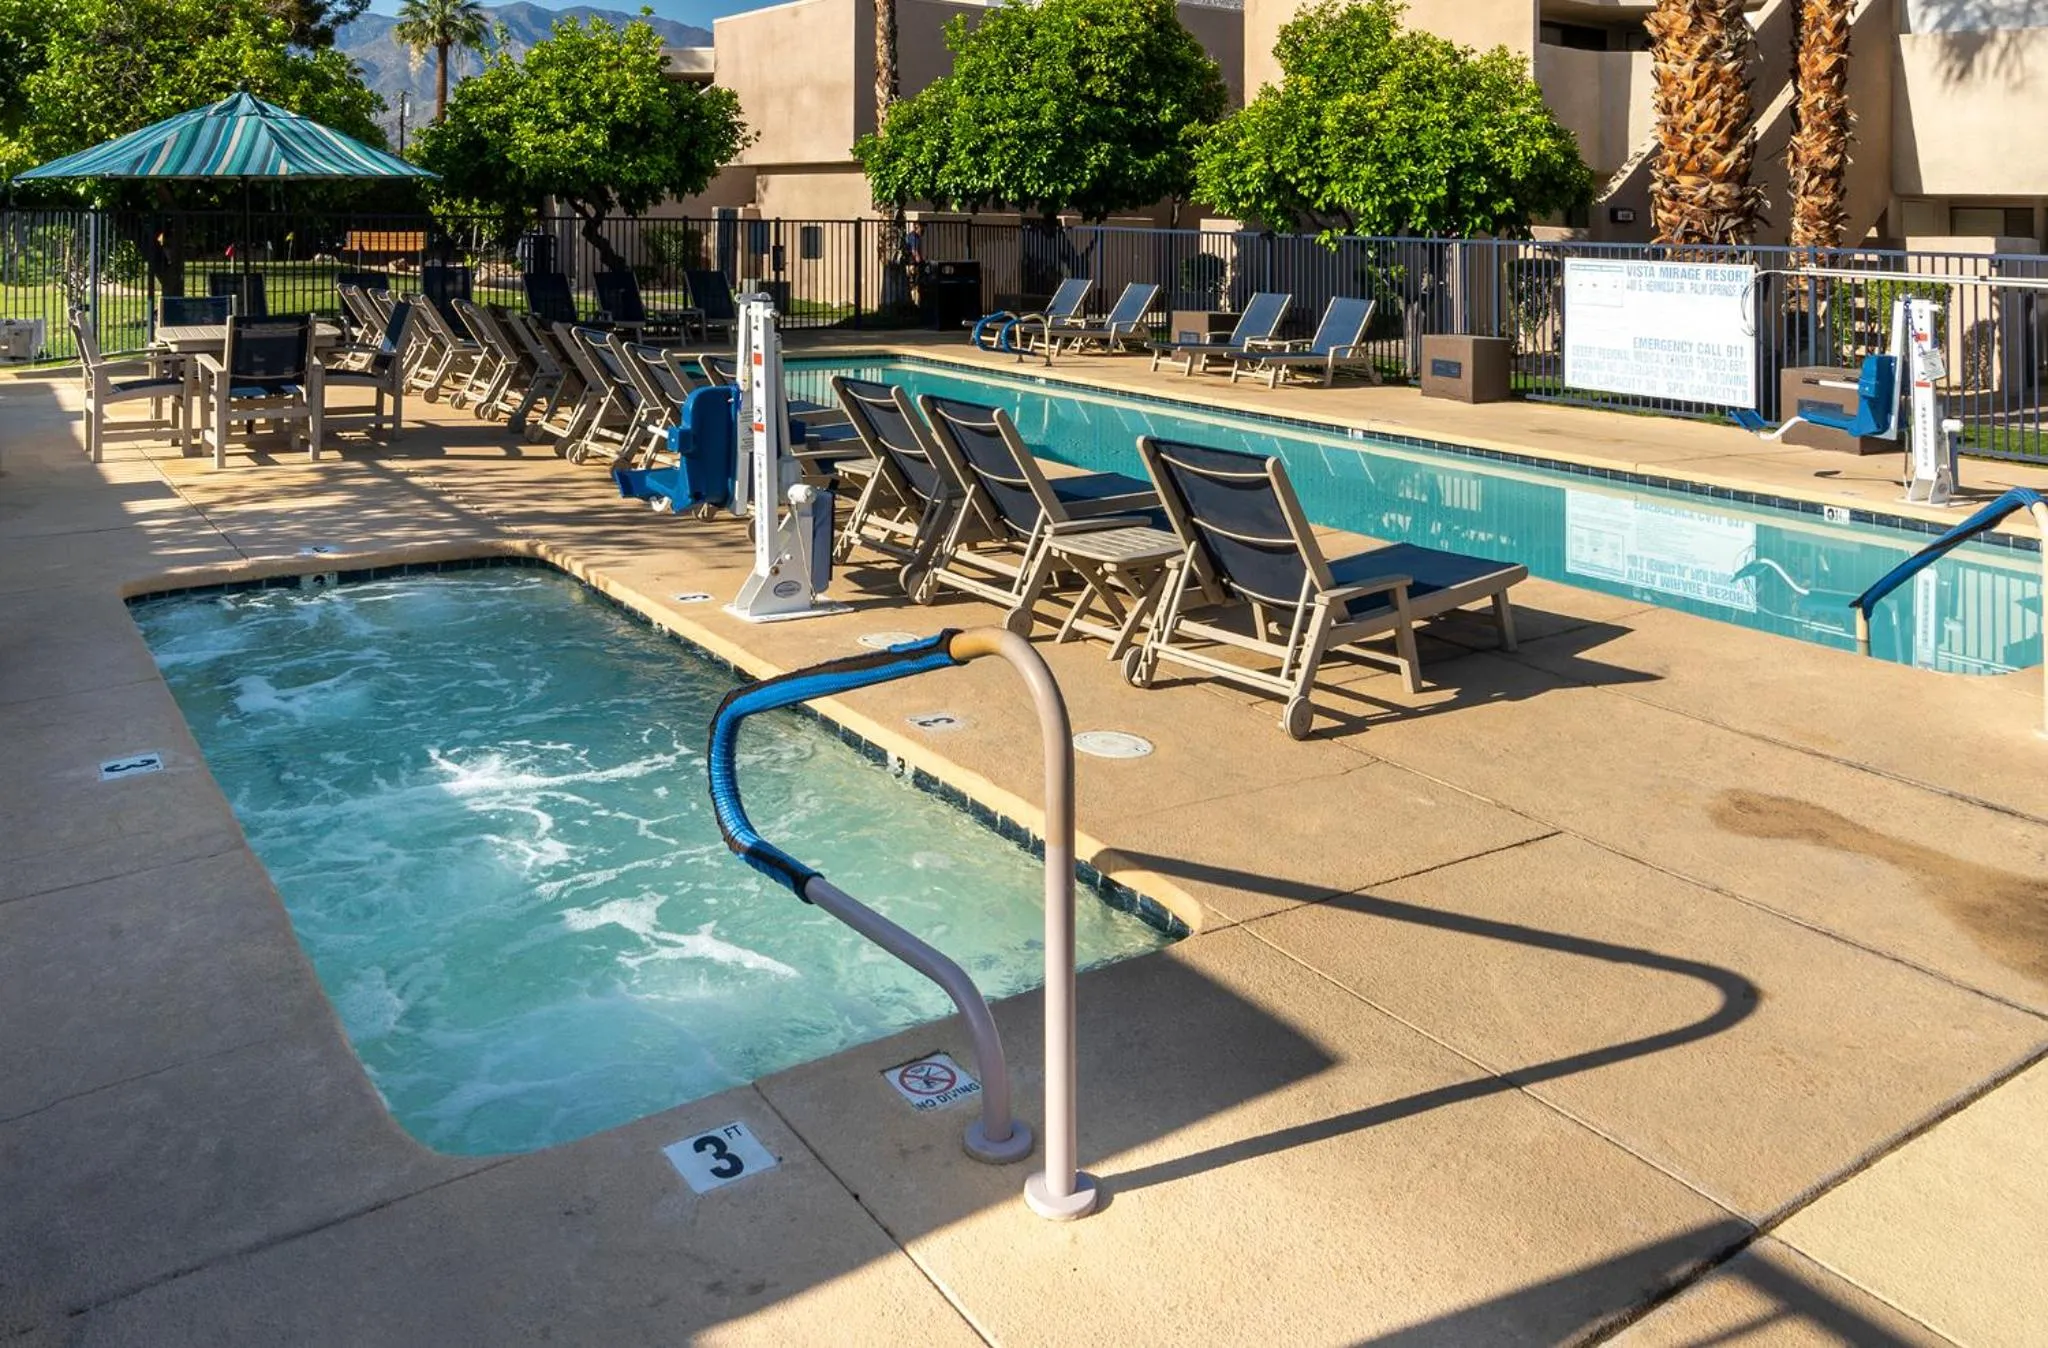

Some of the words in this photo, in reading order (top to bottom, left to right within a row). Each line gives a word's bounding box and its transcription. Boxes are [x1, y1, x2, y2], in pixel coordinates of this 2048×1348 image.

[1626, 265, 1655, 278] VISTA
[1660, 266, 1702, 280] MIRAGE
[1705, 268, 1750, 283] RESORT
[1633, 336, 1693, 353] EMERGENCY
[1697, 342, 1721, 356] CALL
[1726, 345, 1744, 360] 911
[1720, 372, 1748, 388] DIVING
[1667, 382, 1685, 394] SPA
[1689, 384, 1737, 400] CAPACITY
[104, 758, 157, 773] 3
[915, 1098, 937, 1111] NO
[935, 1082, 981, 1104] DIVING
[693, 1135, 744, 1179] 3
[723, 1124, 743, 1140] FT
